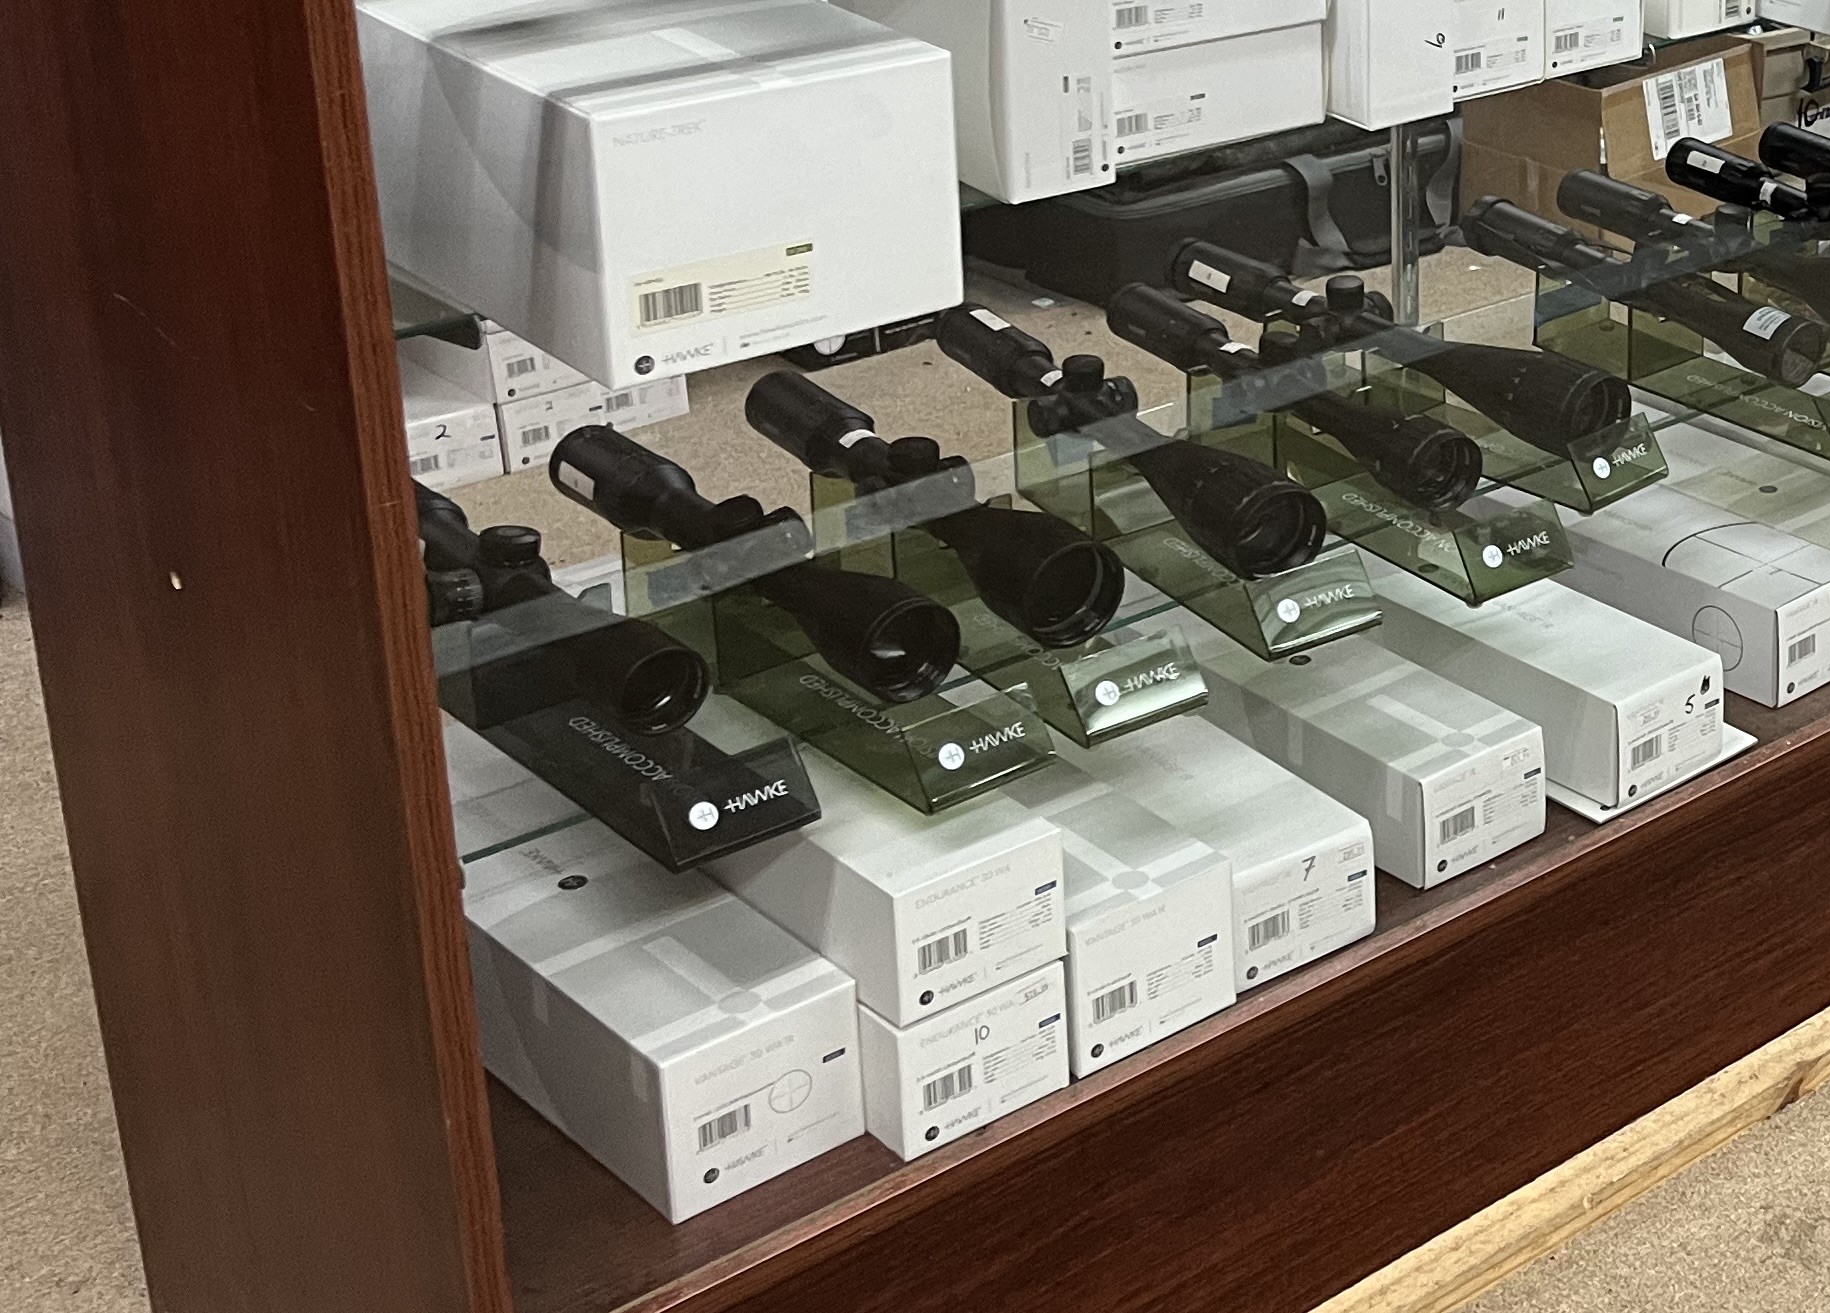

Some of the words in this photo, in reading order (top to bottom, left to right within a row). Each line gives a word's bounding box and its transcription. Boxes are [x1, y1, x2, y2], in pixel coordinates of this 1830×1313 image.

[434, 423, 451, 440] 2
[1611, 442, 1648, 468] HAWKE
[1506, 530, 1551, 556] HAWKE
[1304, 583, 1355, 610] HAWKE
[1123, 661, 1180, 693] HAWKE
[1684, 693, 1696, 715] 5
[567, 715, 674, 782] ACCOMPLISHED
[969, 721, 1026, 754] HAWKE
[722, 779, 789, 813] HAWKE
[1300, 854, 1317, 882] 7
[973, 1024, 991, 1046] 10
